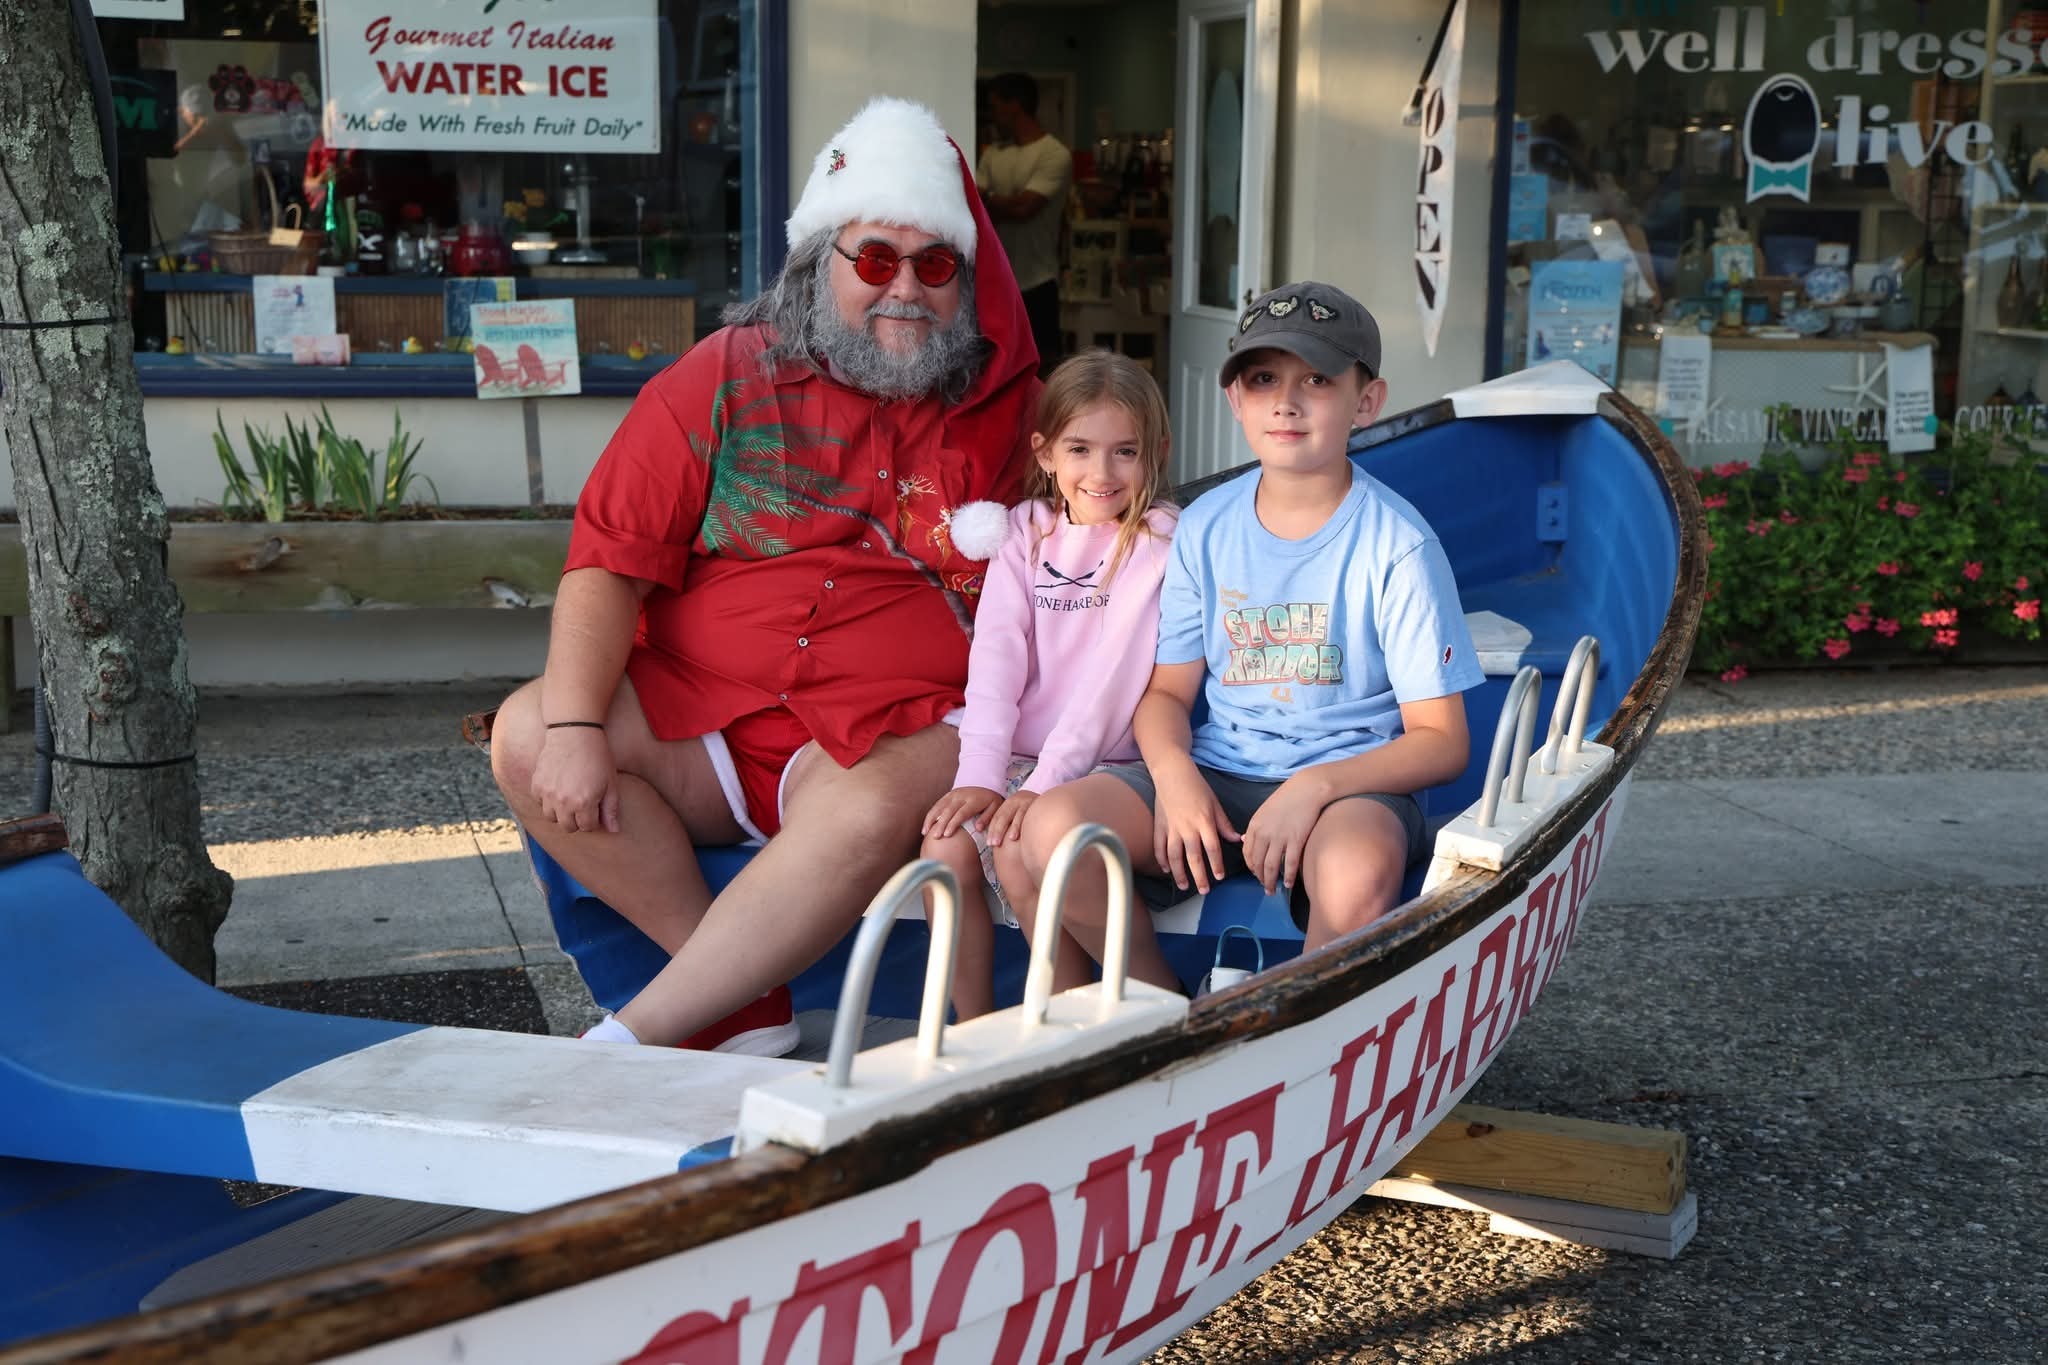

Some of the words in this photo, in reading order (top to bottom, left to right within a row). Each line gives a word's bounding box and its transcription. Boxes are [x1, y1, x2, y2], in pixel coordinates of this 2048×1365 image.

[364, 15, 495, 56] Gourmet
[506, 20, 617, 51] Italian
[1583, 5, 1767, 75] well
[1806, 15, 2048, 79] dress
[375, 60, 527, 97] WATER
[547, 65, 609, 99] ICE
[342, 113, 407, 133] "Made
[418, 114, 466, 134] With
[473, 115, 525, 136] Fresh
[533, 116, 577, 137] Fruit
[583, 118, 644, 141] Daily"
[1414, 86, 1446, 311] OPEN
[1223, 602, 1329, 649] STONE
[1221, 643, 1345, 687] HARBOR
